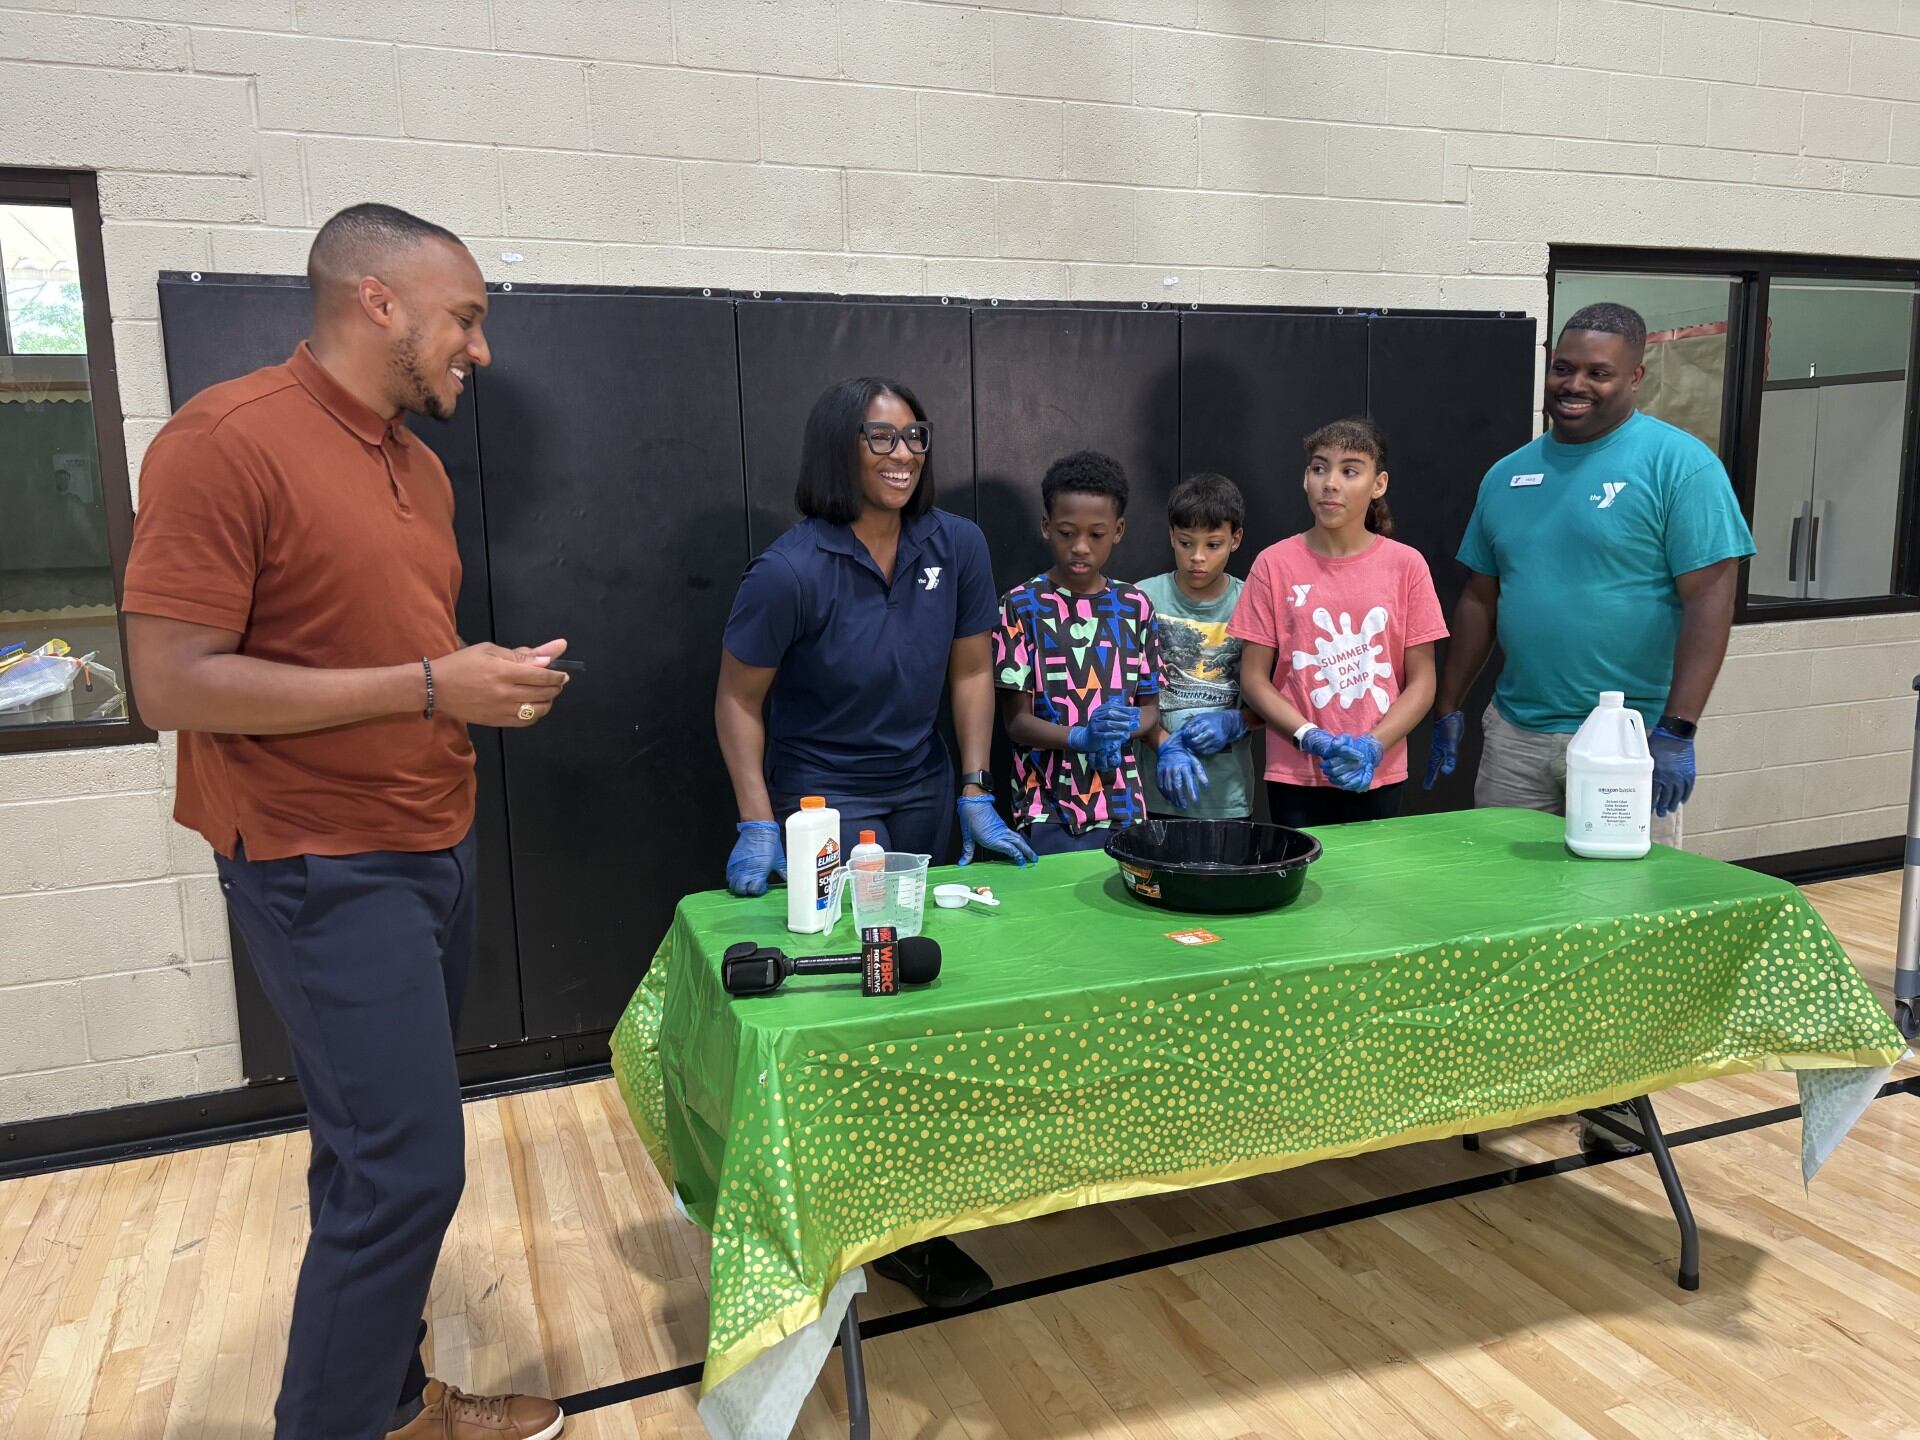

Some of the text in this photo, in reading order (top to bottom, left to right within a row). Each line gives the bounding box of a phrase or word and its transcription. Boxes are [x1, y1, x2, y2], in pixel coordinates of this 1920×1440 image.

[1321, 643, 1370, 668] SUMMER
[1338, 660, 1361, 676] DAY
[1339, 671, 1370, 690] CAMP
[873, 969, 881, 993] NEWS
[880, 945, 894, 993] WBRC
